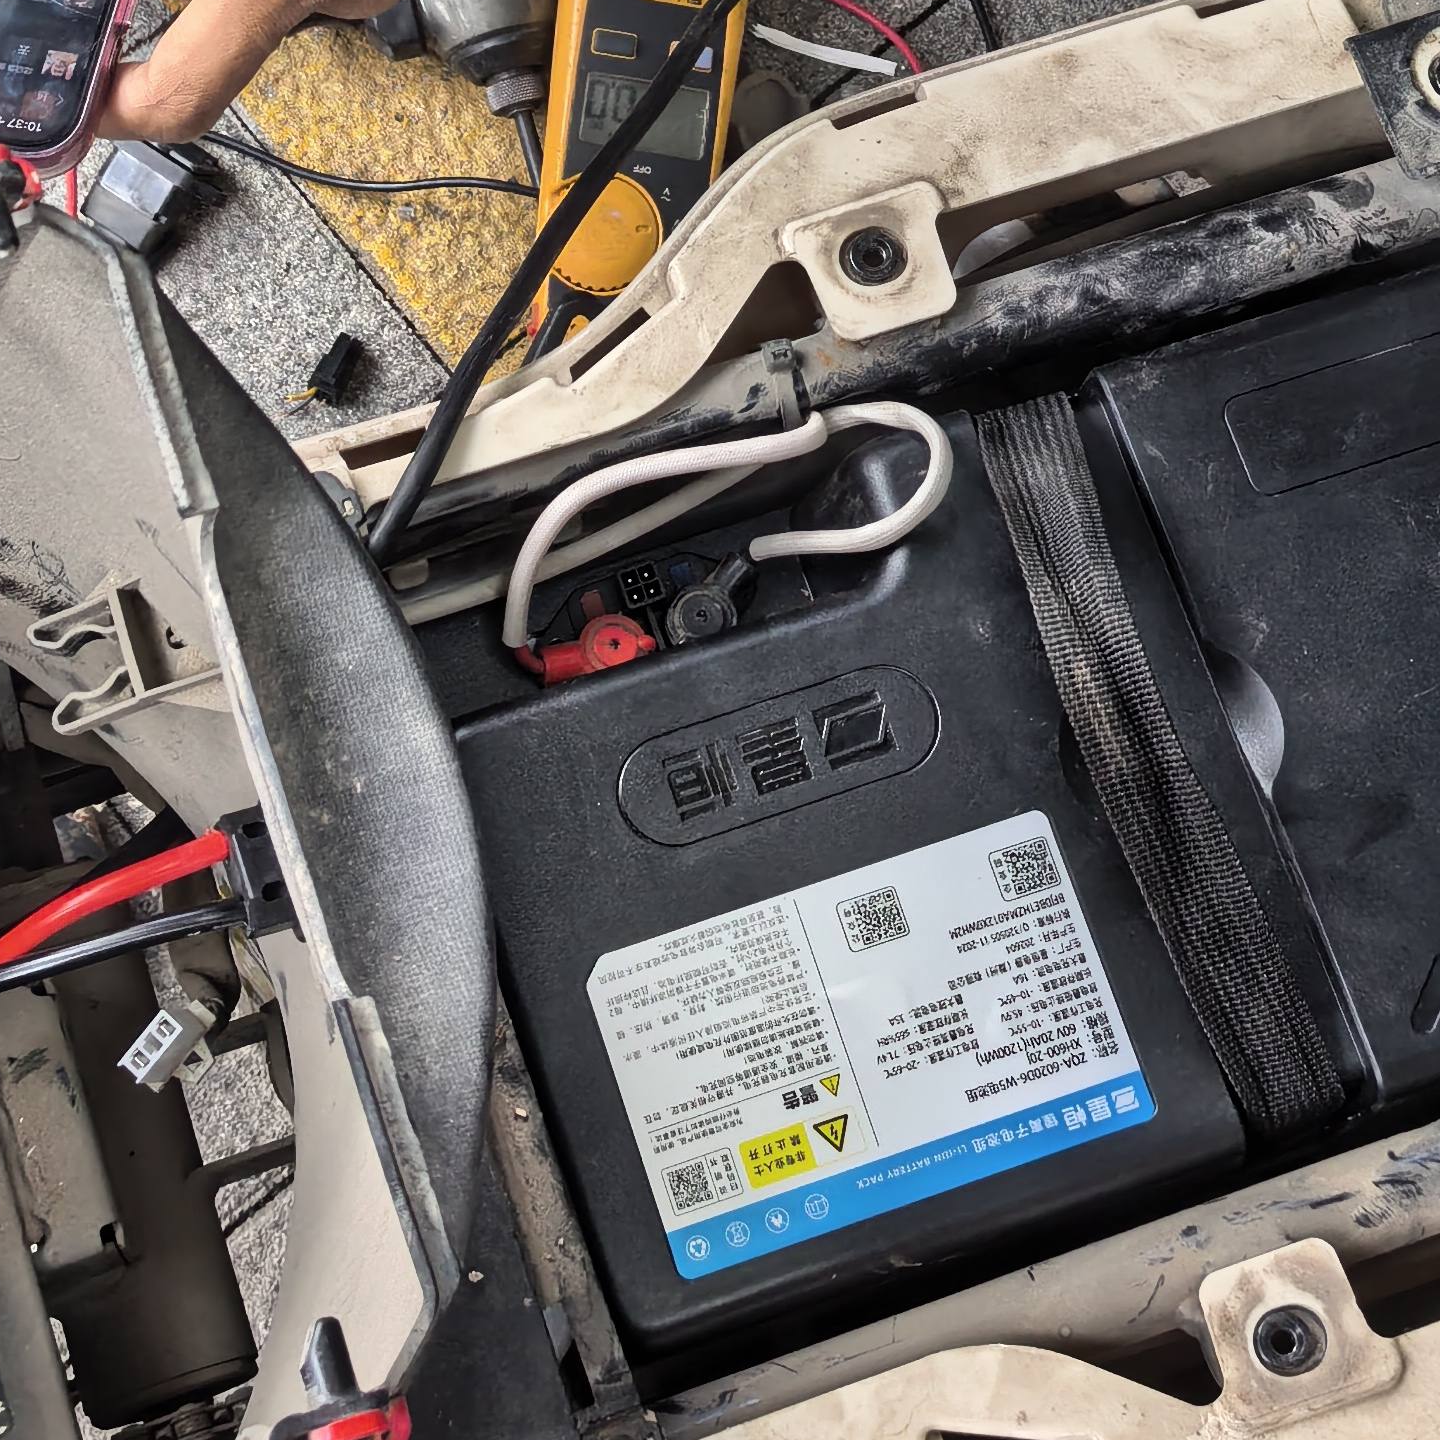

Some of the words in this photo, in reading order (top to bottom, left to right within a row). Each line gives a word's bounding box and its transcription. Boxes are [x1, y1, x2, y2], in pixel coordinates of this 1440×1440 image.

[6, 116, 42, 134] 10:37
[632, 163, 652, 174] OFF
[780, 1082, 819, 1112] 警告
[884, 1155, 931, 1179] BATTERY
[855, 1171, 884, 1189] PACK
